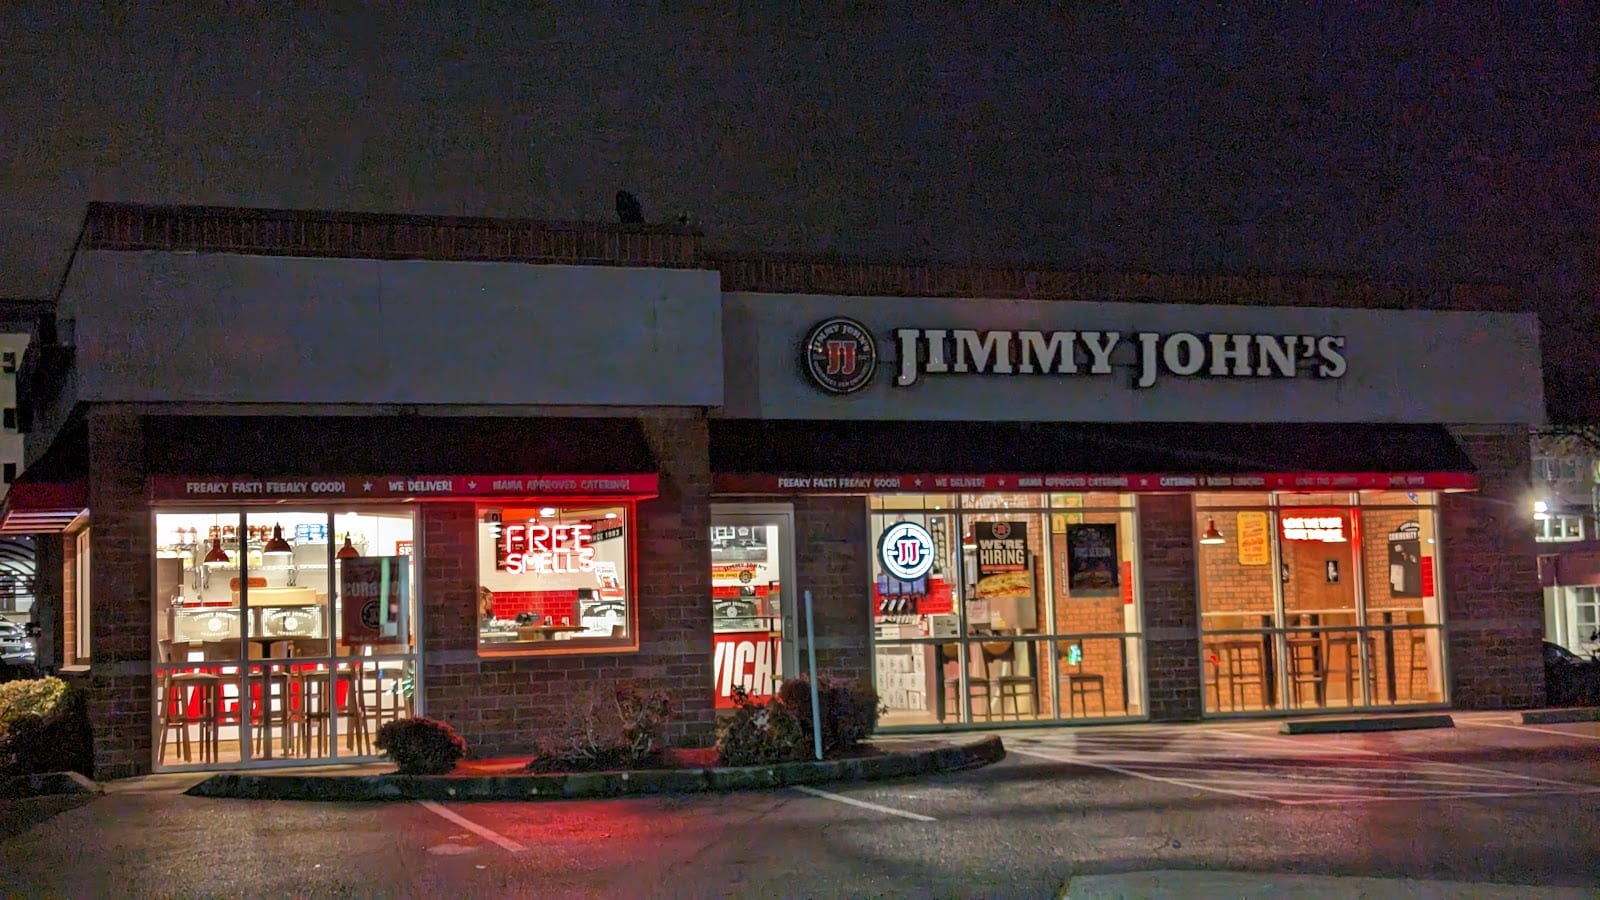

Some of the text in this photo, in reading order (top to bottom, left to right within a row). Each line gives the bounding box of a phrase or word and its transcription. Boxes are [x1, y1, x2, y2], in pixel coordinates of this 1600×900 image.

[826, 340, 857, 375] JJ
[897, 328, 1120, 386] JIMMY
[1138, 332, 1347, 388] JOHN'S
[186, 481, 346, 493] FREAKY FAST! FREAKY GOOD!
[388, 480, 452, 492] WE DELIVER!
[778, 477, 811, 488] FREAKY
[840, 478, 871, 488] FREAKY
[506, 524, 595, 575] FREE SMELLS
[979, 539, 1025, 550] WE'RE
[897, 540, 920, 566] JJ
[980, 549, 1025, 565] HIRING
